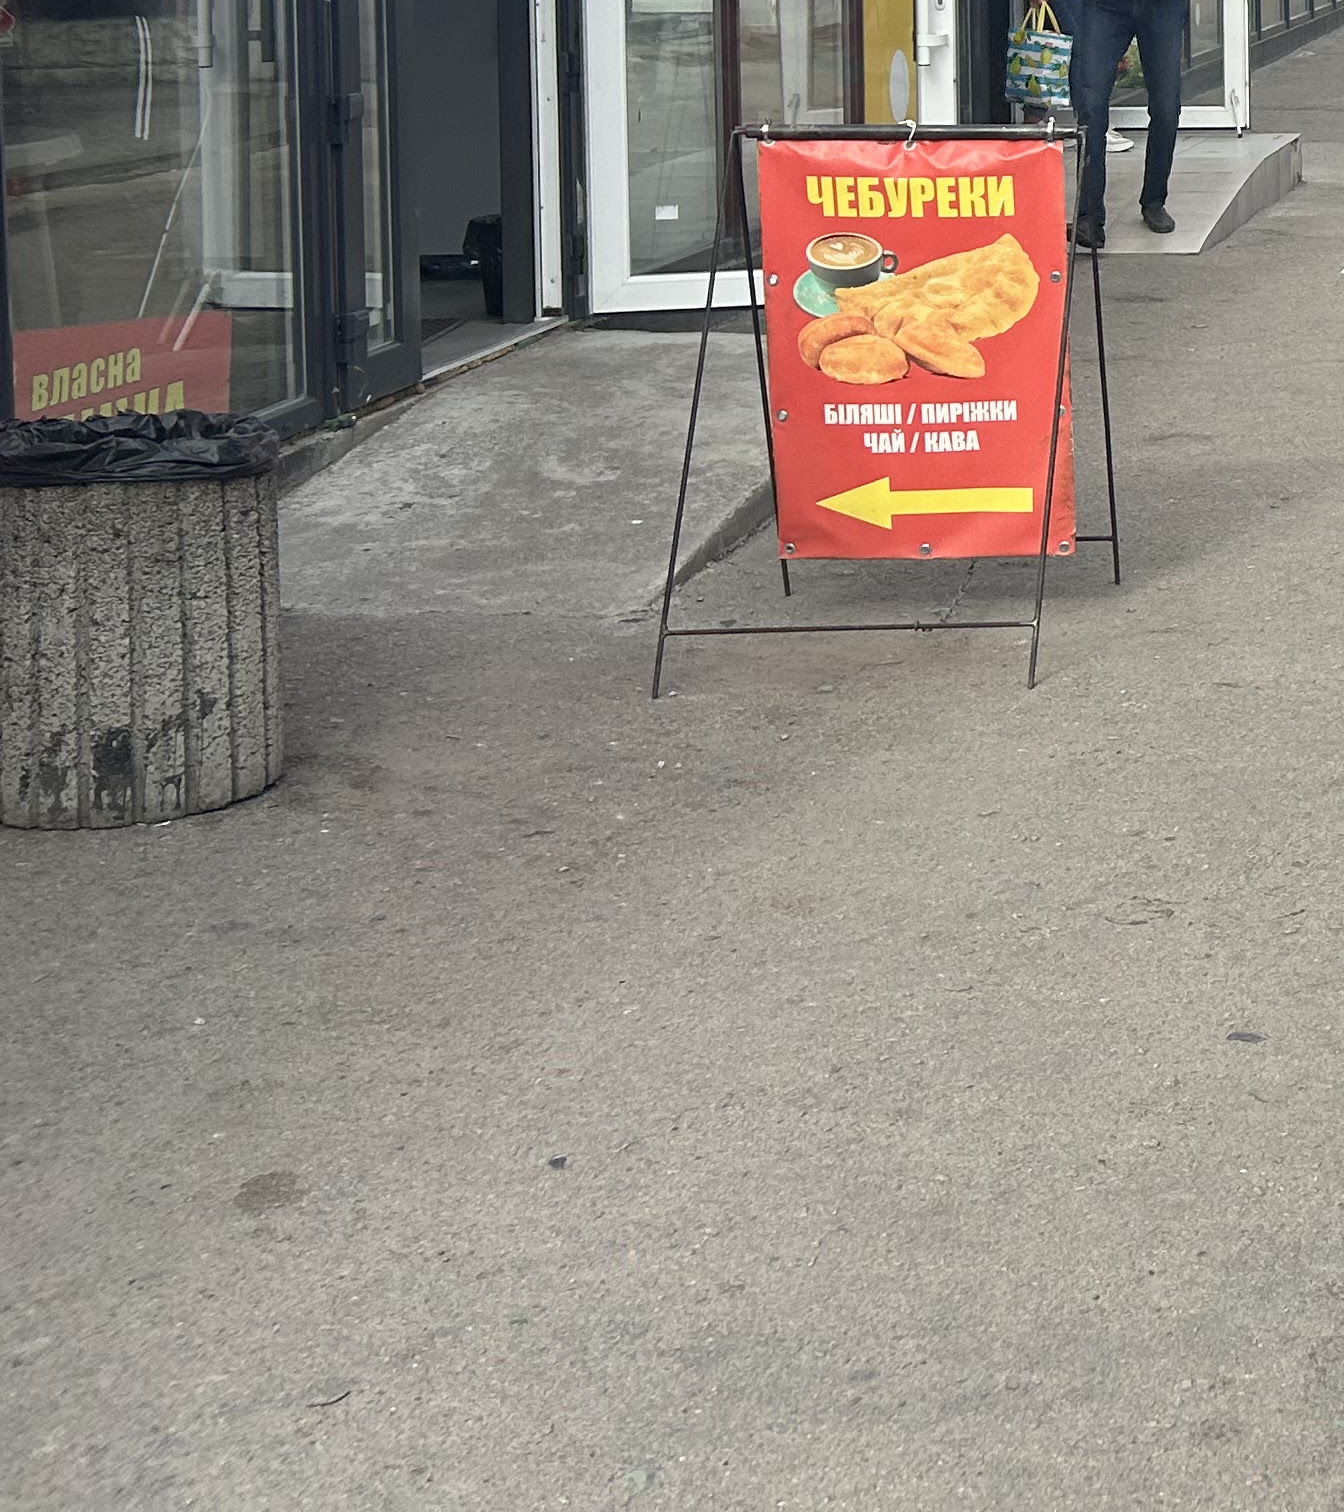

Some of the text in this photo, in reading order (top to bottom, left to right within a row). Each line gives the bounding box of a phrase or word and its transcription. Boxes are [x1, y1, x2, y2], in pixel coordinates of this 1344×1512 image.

[806, 175, 1016, 219] ЧЕБУРЕКИ
[32, 347, 141, 412] власна
[824, 403, 902, 425] БІЛЯШІ
[921, 400, 1018, 423] ПИРІЖКИ
[864, 429, 906, 454] ЧАЙ
[925, 430, 981, 453] КАВА
